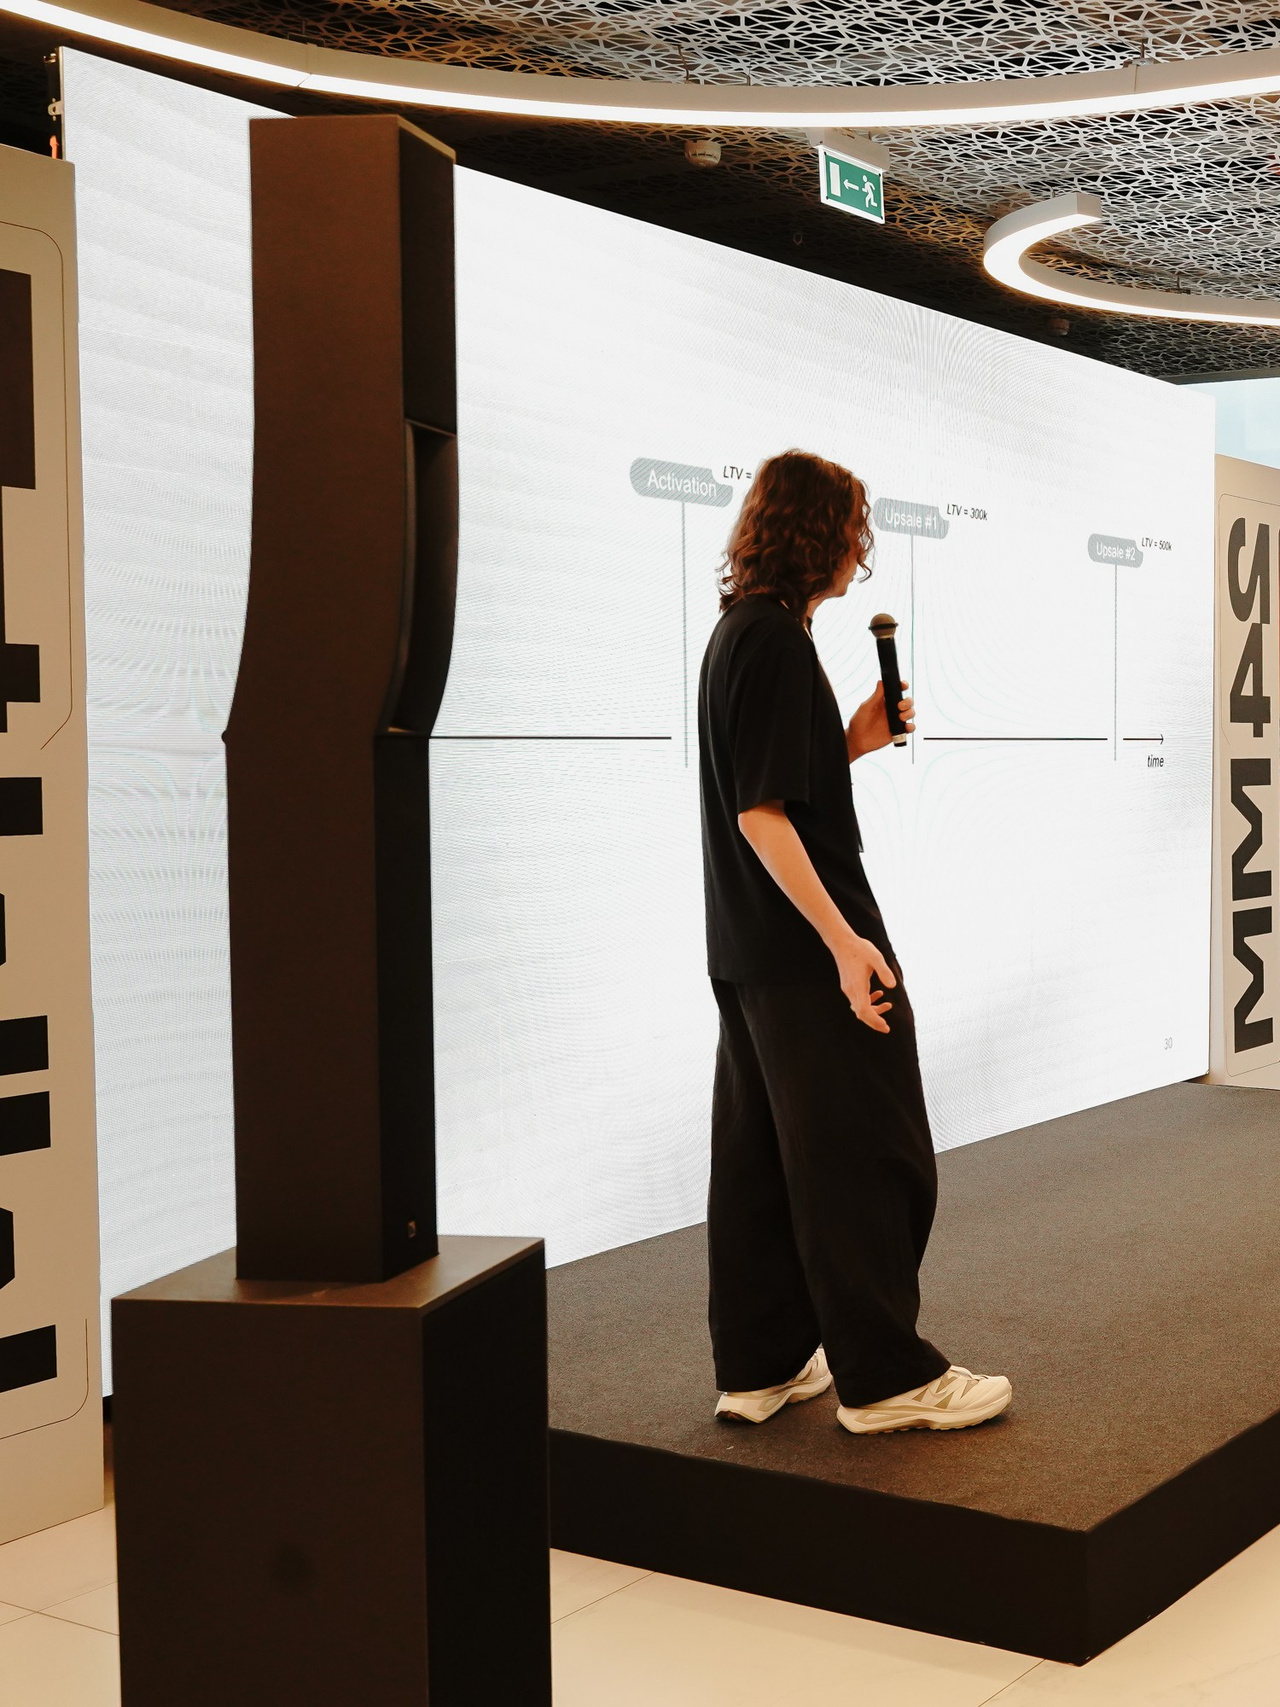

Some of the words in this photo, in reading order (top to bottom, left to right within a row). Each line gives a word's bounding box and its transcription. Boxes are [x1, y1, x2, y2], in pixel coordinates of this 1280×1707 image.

[723, 465, 743, 480] LTV
[647, 469, 717, 497] Activation
[885, 507, 922, 528] Upsale
[924, 514, 937, 530] #1
[946, 503, 962, 516] LTV
[970, 507, 988, 521] 300k
[1096, 541, 1124, 559] Upsale
[1125, 546, 1136, 561] #2
[1141, 537, 1153, 548] LTV
[1147, 754, 1164, 768] time
